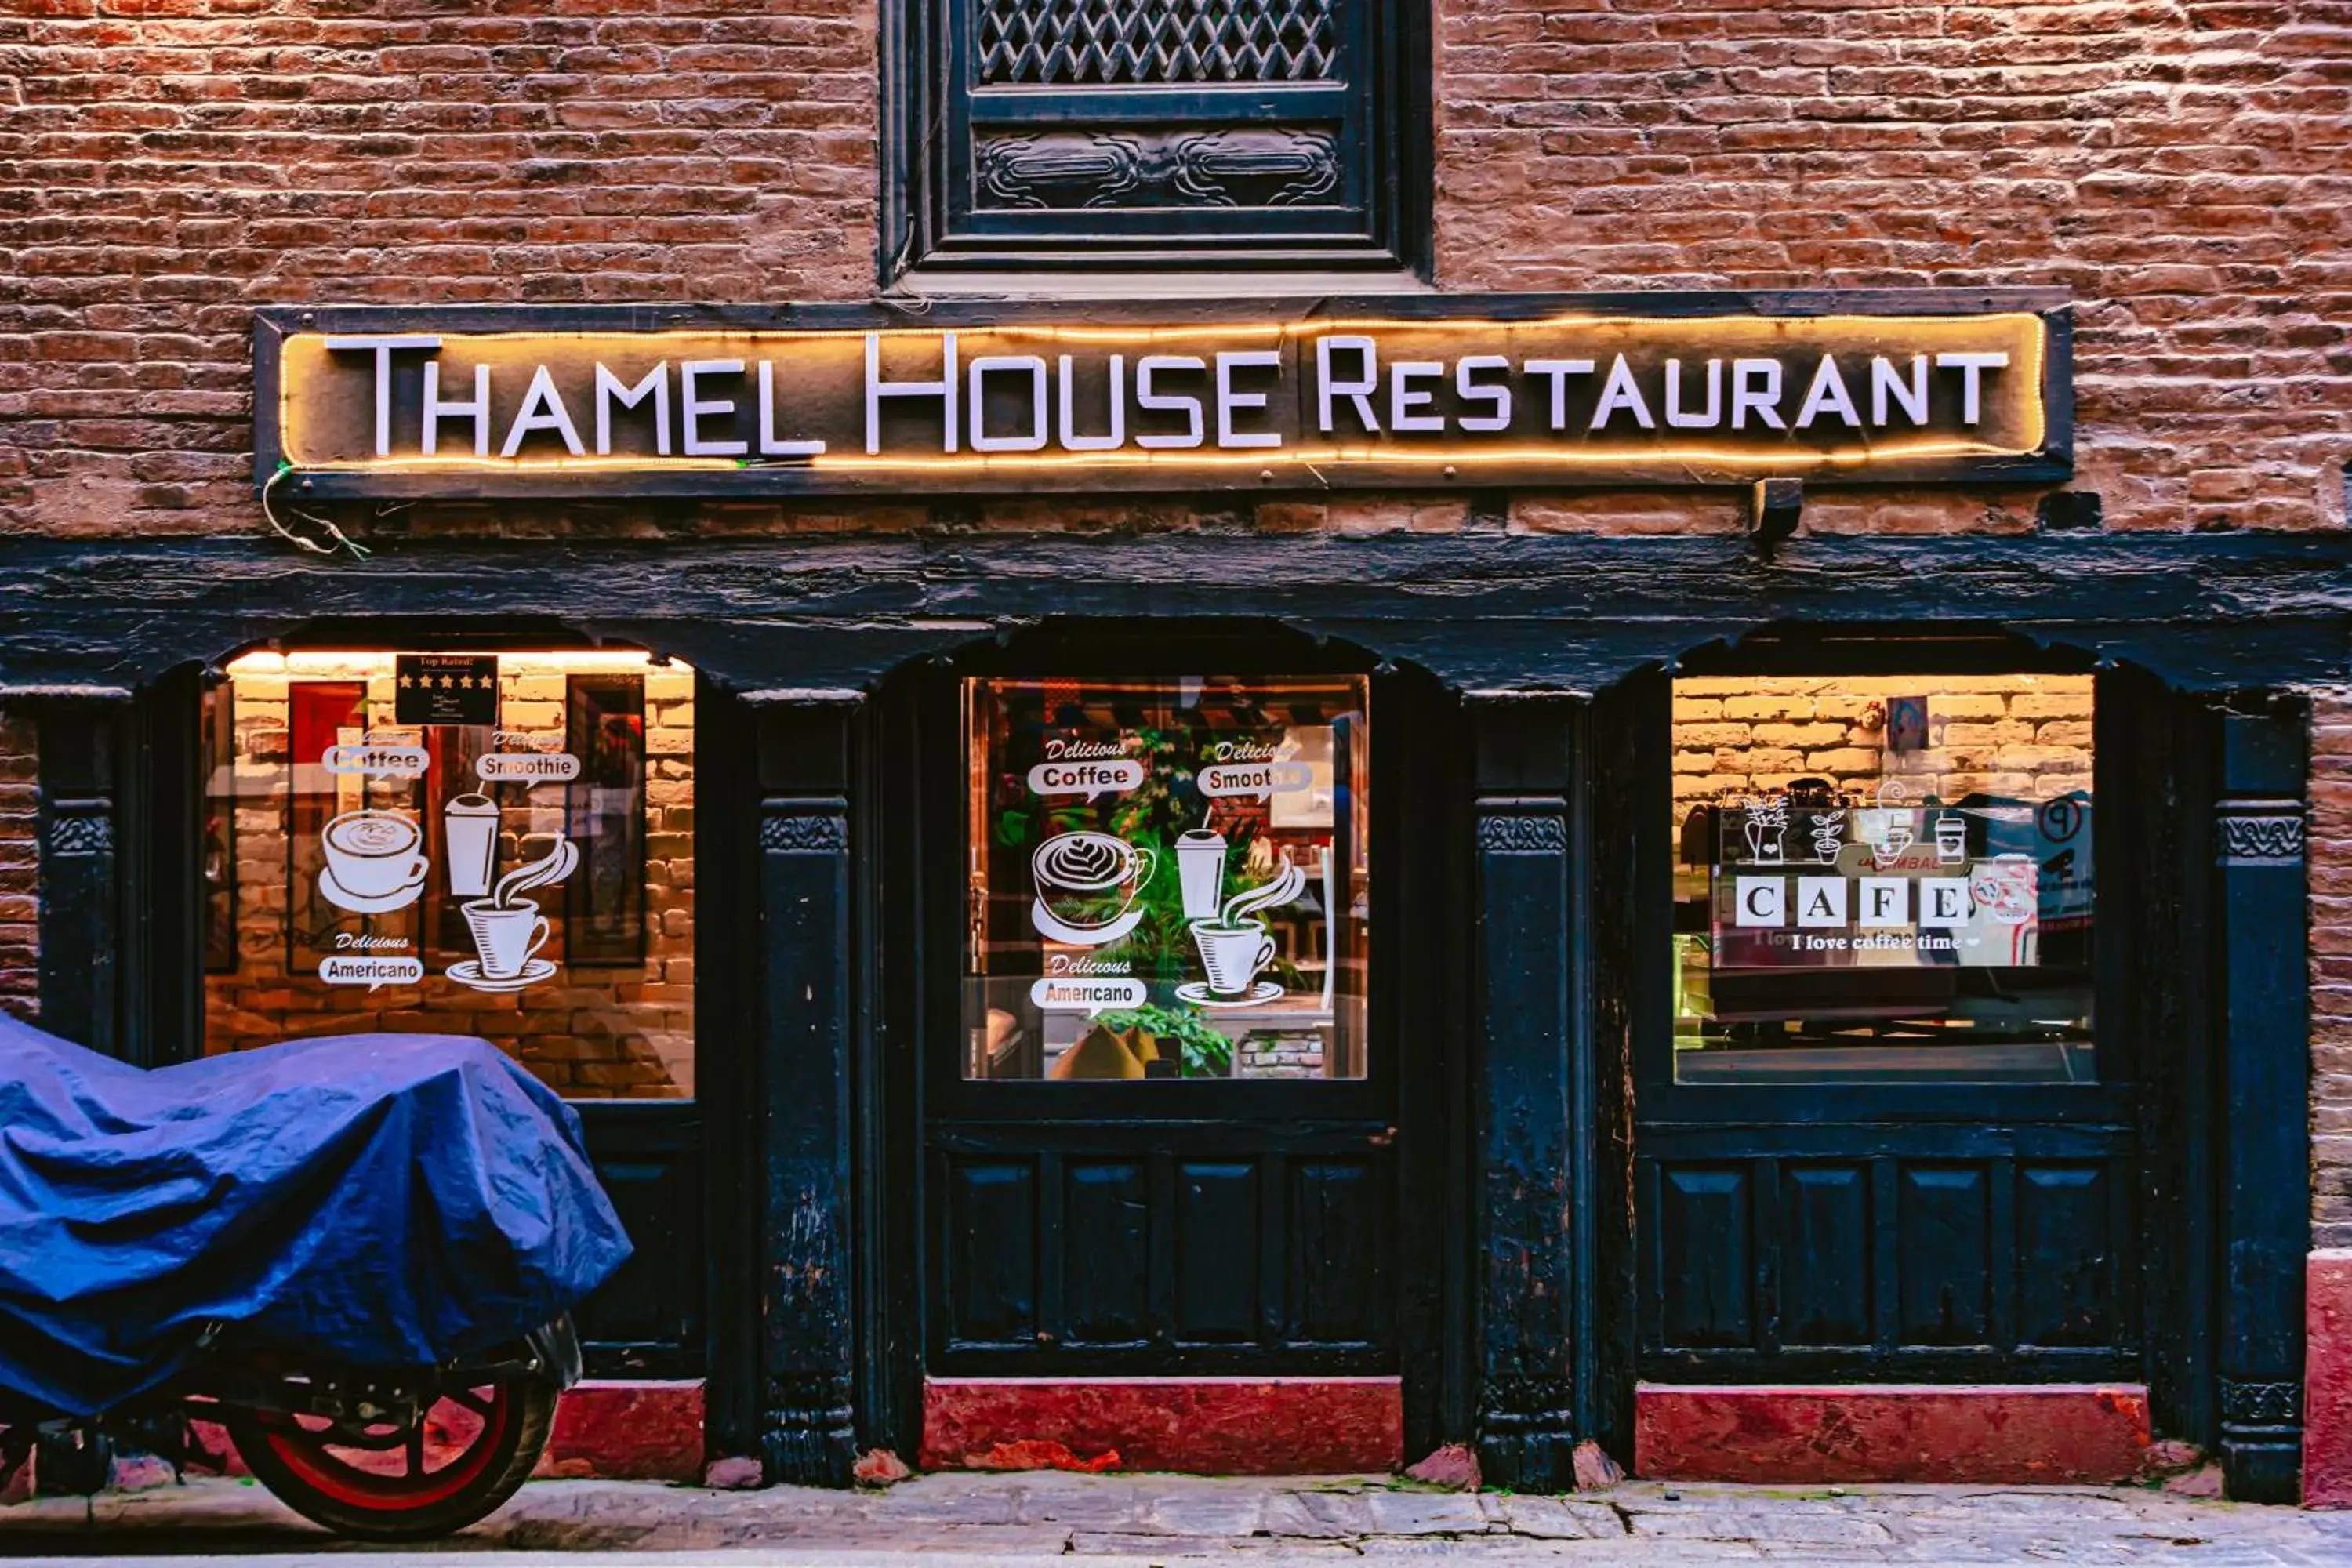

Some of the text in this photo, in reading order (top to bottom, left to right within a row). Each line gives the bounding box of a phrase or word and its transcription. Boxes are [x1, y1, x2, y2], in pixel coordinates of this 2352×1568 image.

[325, 333, 2009, 456] THAMEL HOUSE RESTAURANT
[421, 657, 438, 666] Top
[1045, 739, 1128, 759] Delicious
[333, 750, 419, 768] Coffee
[485, 757, 572, 774] Smoothie
[1043, 766, 1129, 787] Coffee
[1747, 887, 1958, 918] CAFE
[335, 932, 408, 949] Delicious
[1792, 934, 1800, 950] I
[1806, 934, 1847, 950] love
[1853, 934, 1913, 950] coffee
[1917, 934, 1962, 950] time
[328, 960, 418, 978] Americano
[1051, 954, 1131, 974] Delicious
[1045, 982, 1133, 1002] Americano
